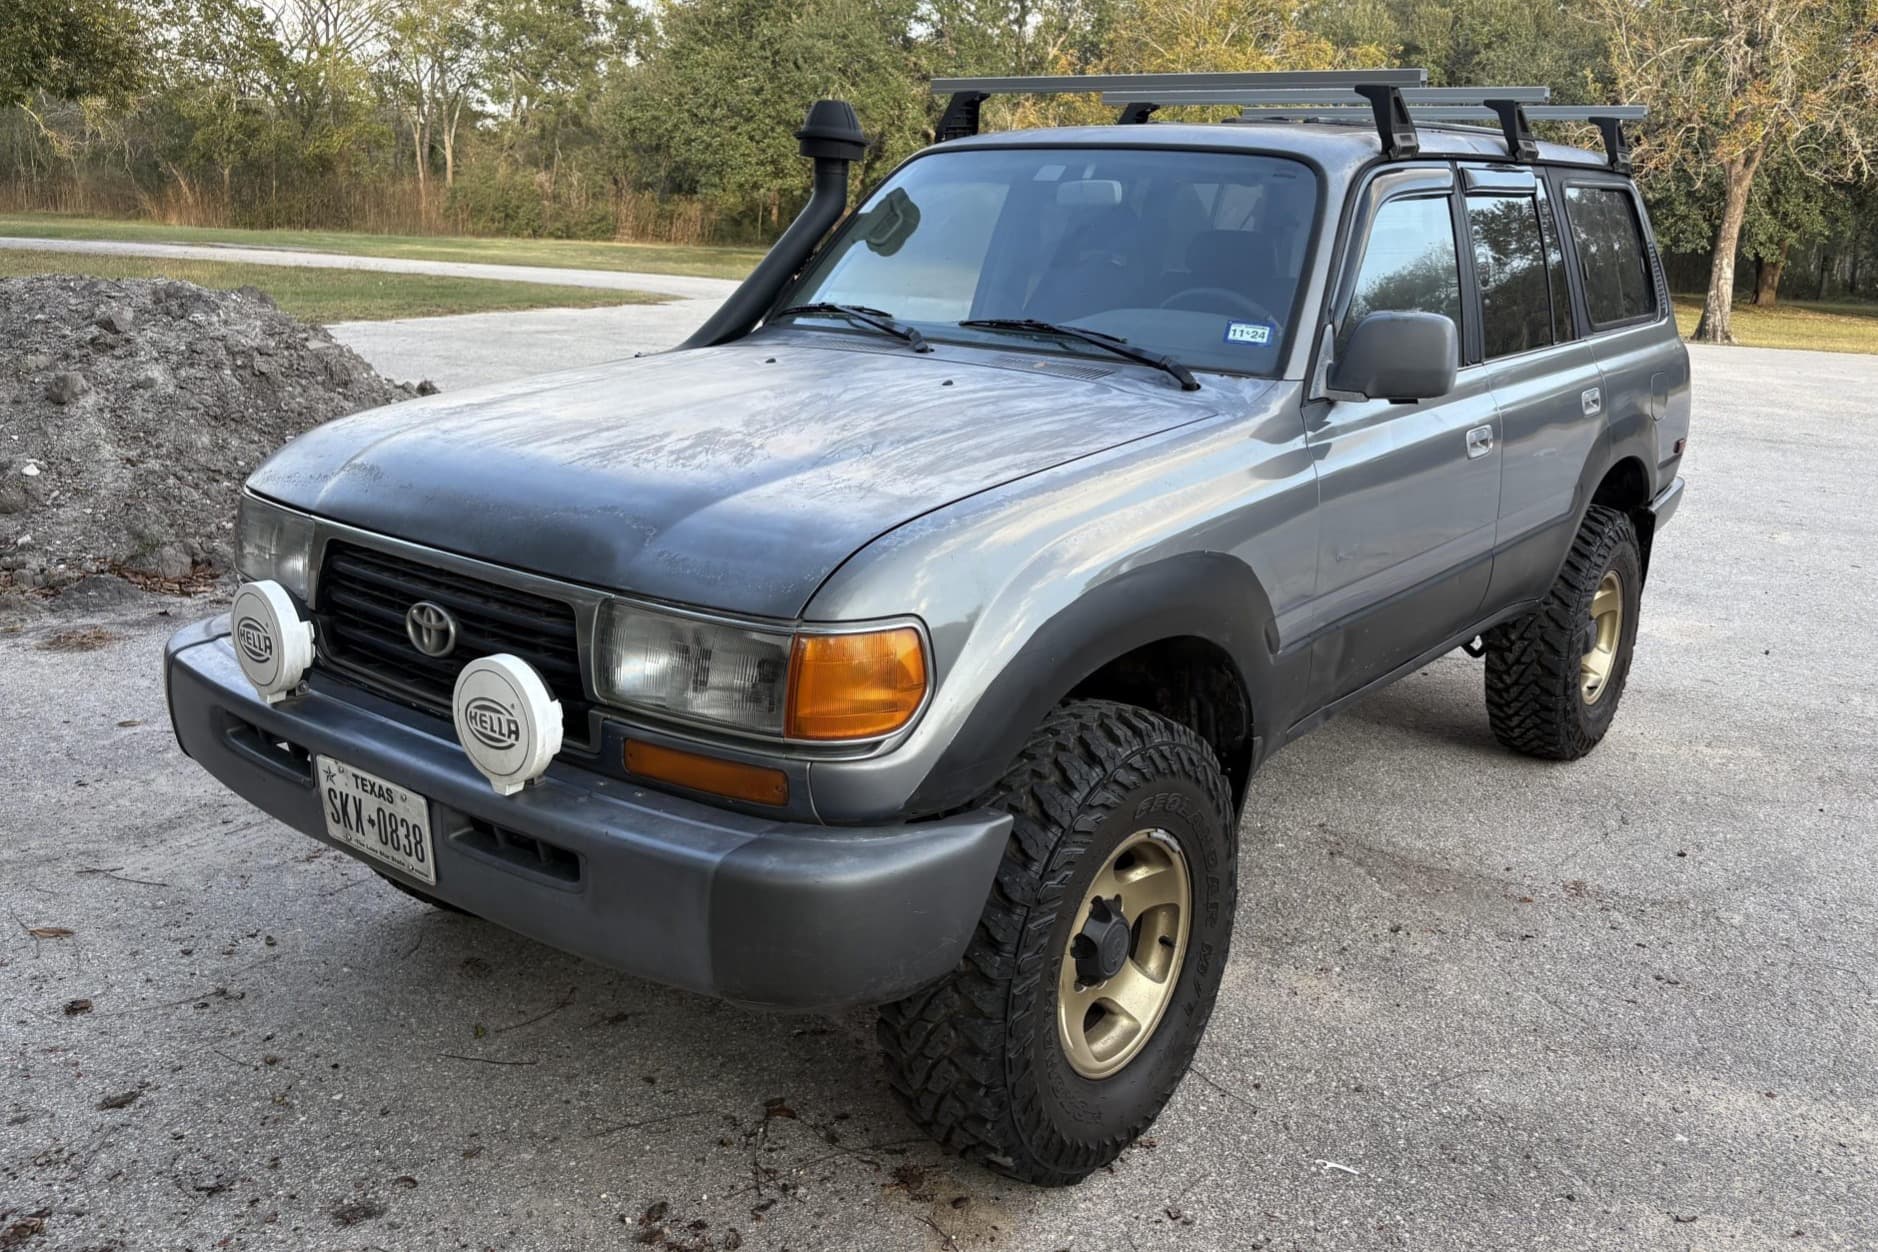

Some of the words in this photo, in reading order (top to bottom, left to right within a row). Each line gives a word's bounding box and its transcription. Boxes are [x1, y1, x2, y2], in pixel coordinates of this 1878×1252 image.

[240, 628, 272, 657] HELLA
[469, 710, 520, 742] HELLA
[352, 772, 394, 804] TEXAS
[376, 807, 425, 863] 0838
